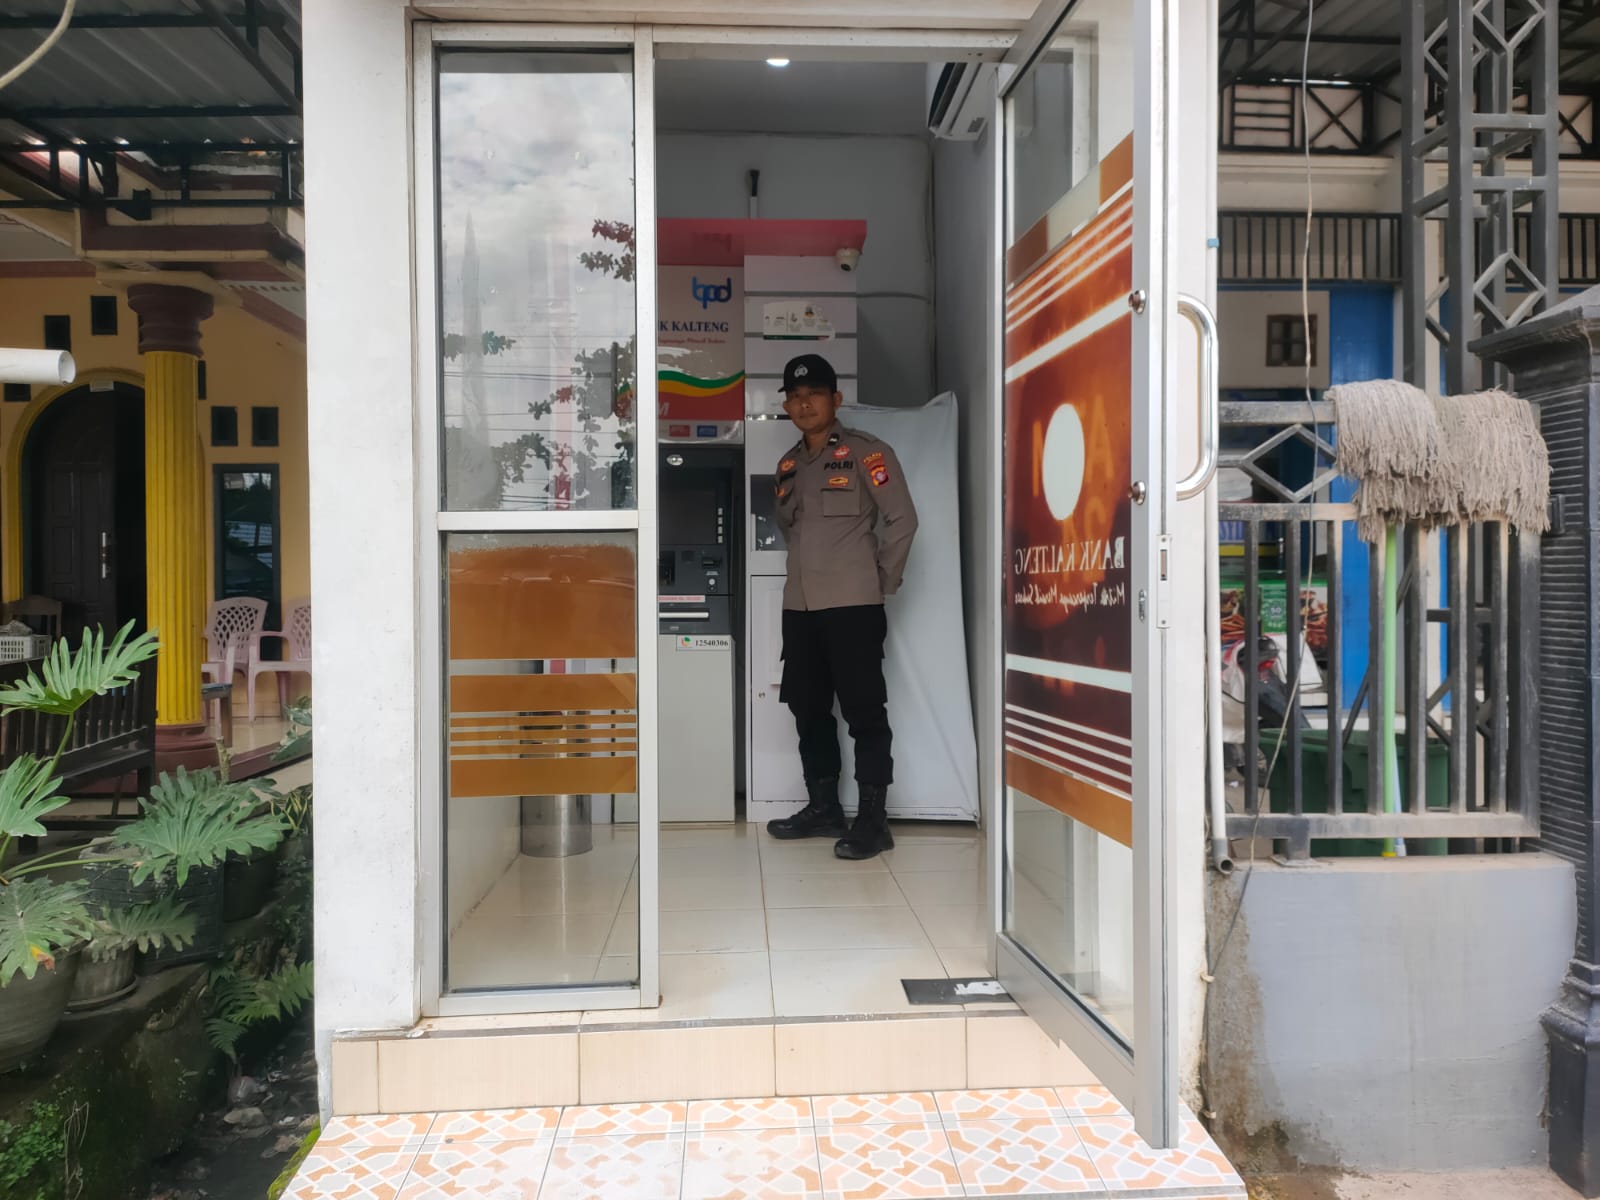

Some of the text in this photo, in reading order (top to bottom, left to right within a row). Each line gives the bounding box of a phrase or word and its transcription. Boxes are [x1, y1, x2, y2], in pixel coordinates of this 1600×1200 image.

[692, 276, 732, 310] bpd
[672, 321, 729, 333] KALTENG
[824, 460, 853, 470] POLRI
[695, 639, 729, 647] 12540306
